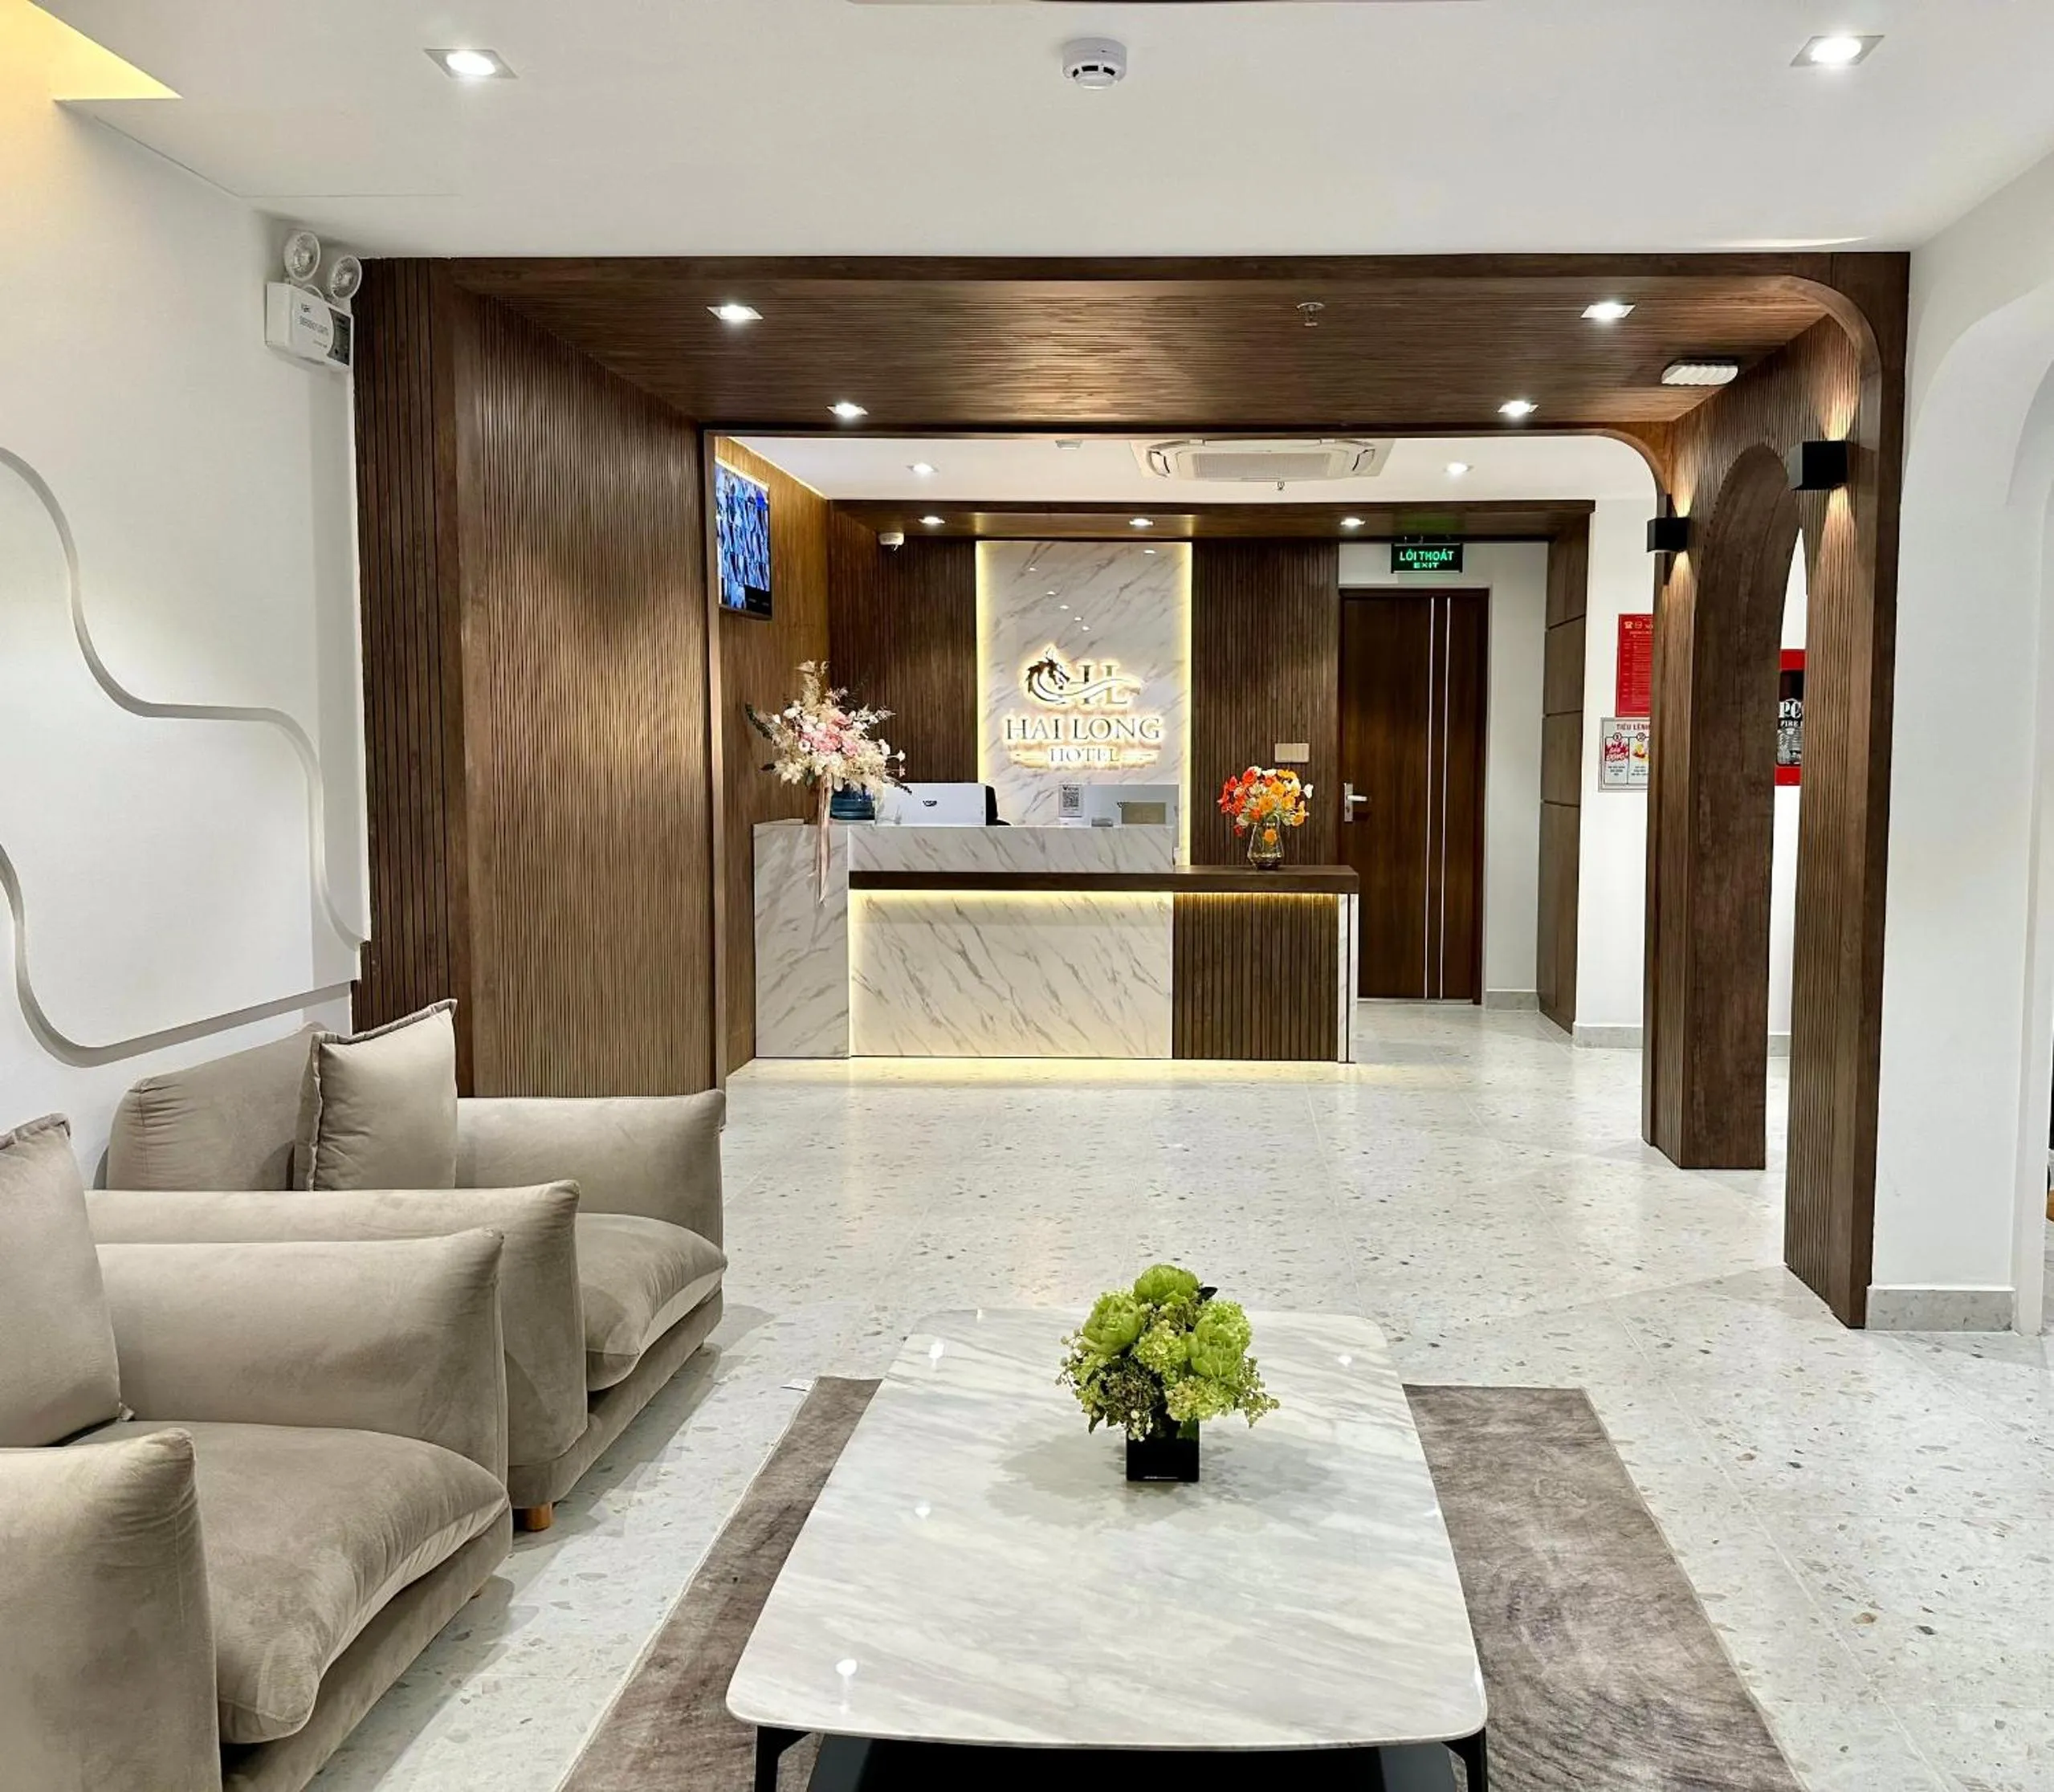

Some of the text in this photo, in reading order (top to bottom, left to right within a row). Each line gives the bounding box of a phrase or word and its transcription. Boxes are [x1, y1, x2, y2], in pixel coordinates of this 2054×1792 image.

[1418, 548, 1454, 561] THOÁT
[1006, 718, 1160, 740] HAI LONG
[1049, 747, 1120, 763] HOTEL
